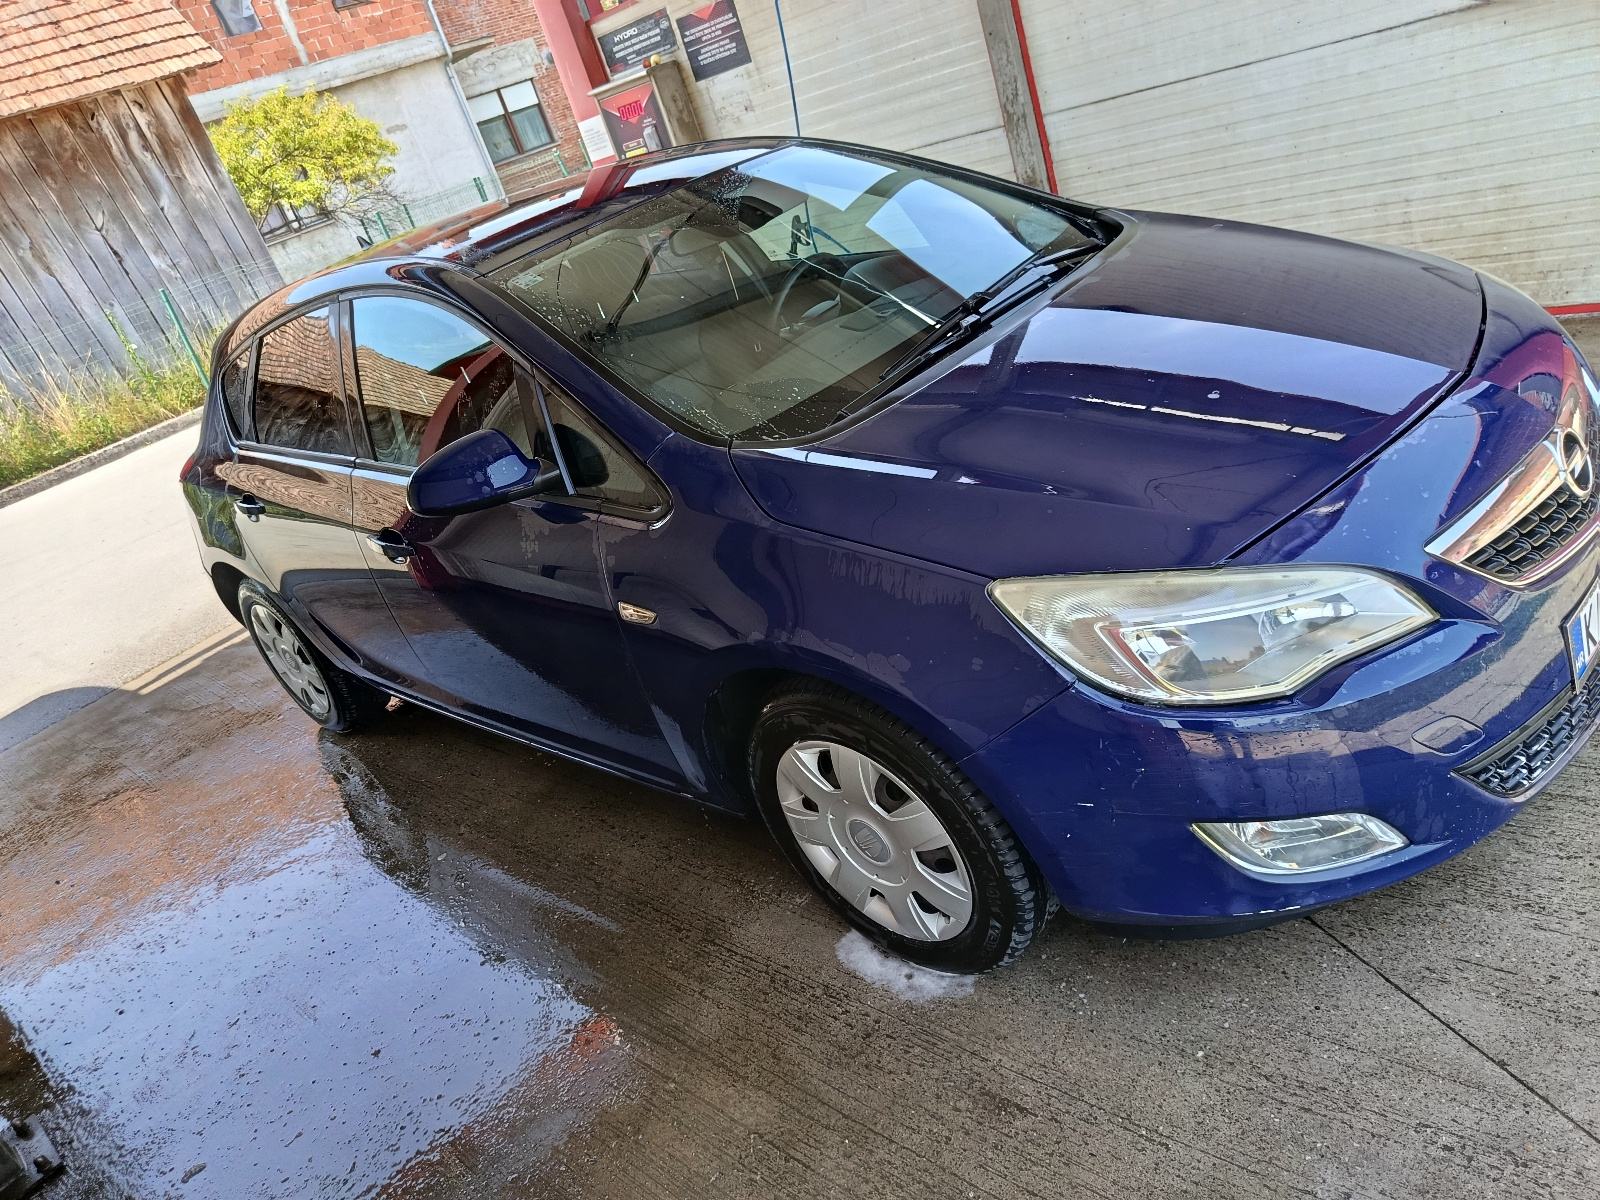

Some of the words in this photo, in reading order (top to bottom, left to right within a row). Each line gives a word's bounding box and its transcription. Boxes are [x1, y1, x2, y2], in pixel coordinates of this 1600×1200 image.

[613, 27, 638, 43] HYDRO
[1584, 593, 1600, 657] K
[1575, 651, 1585, 673] HR
